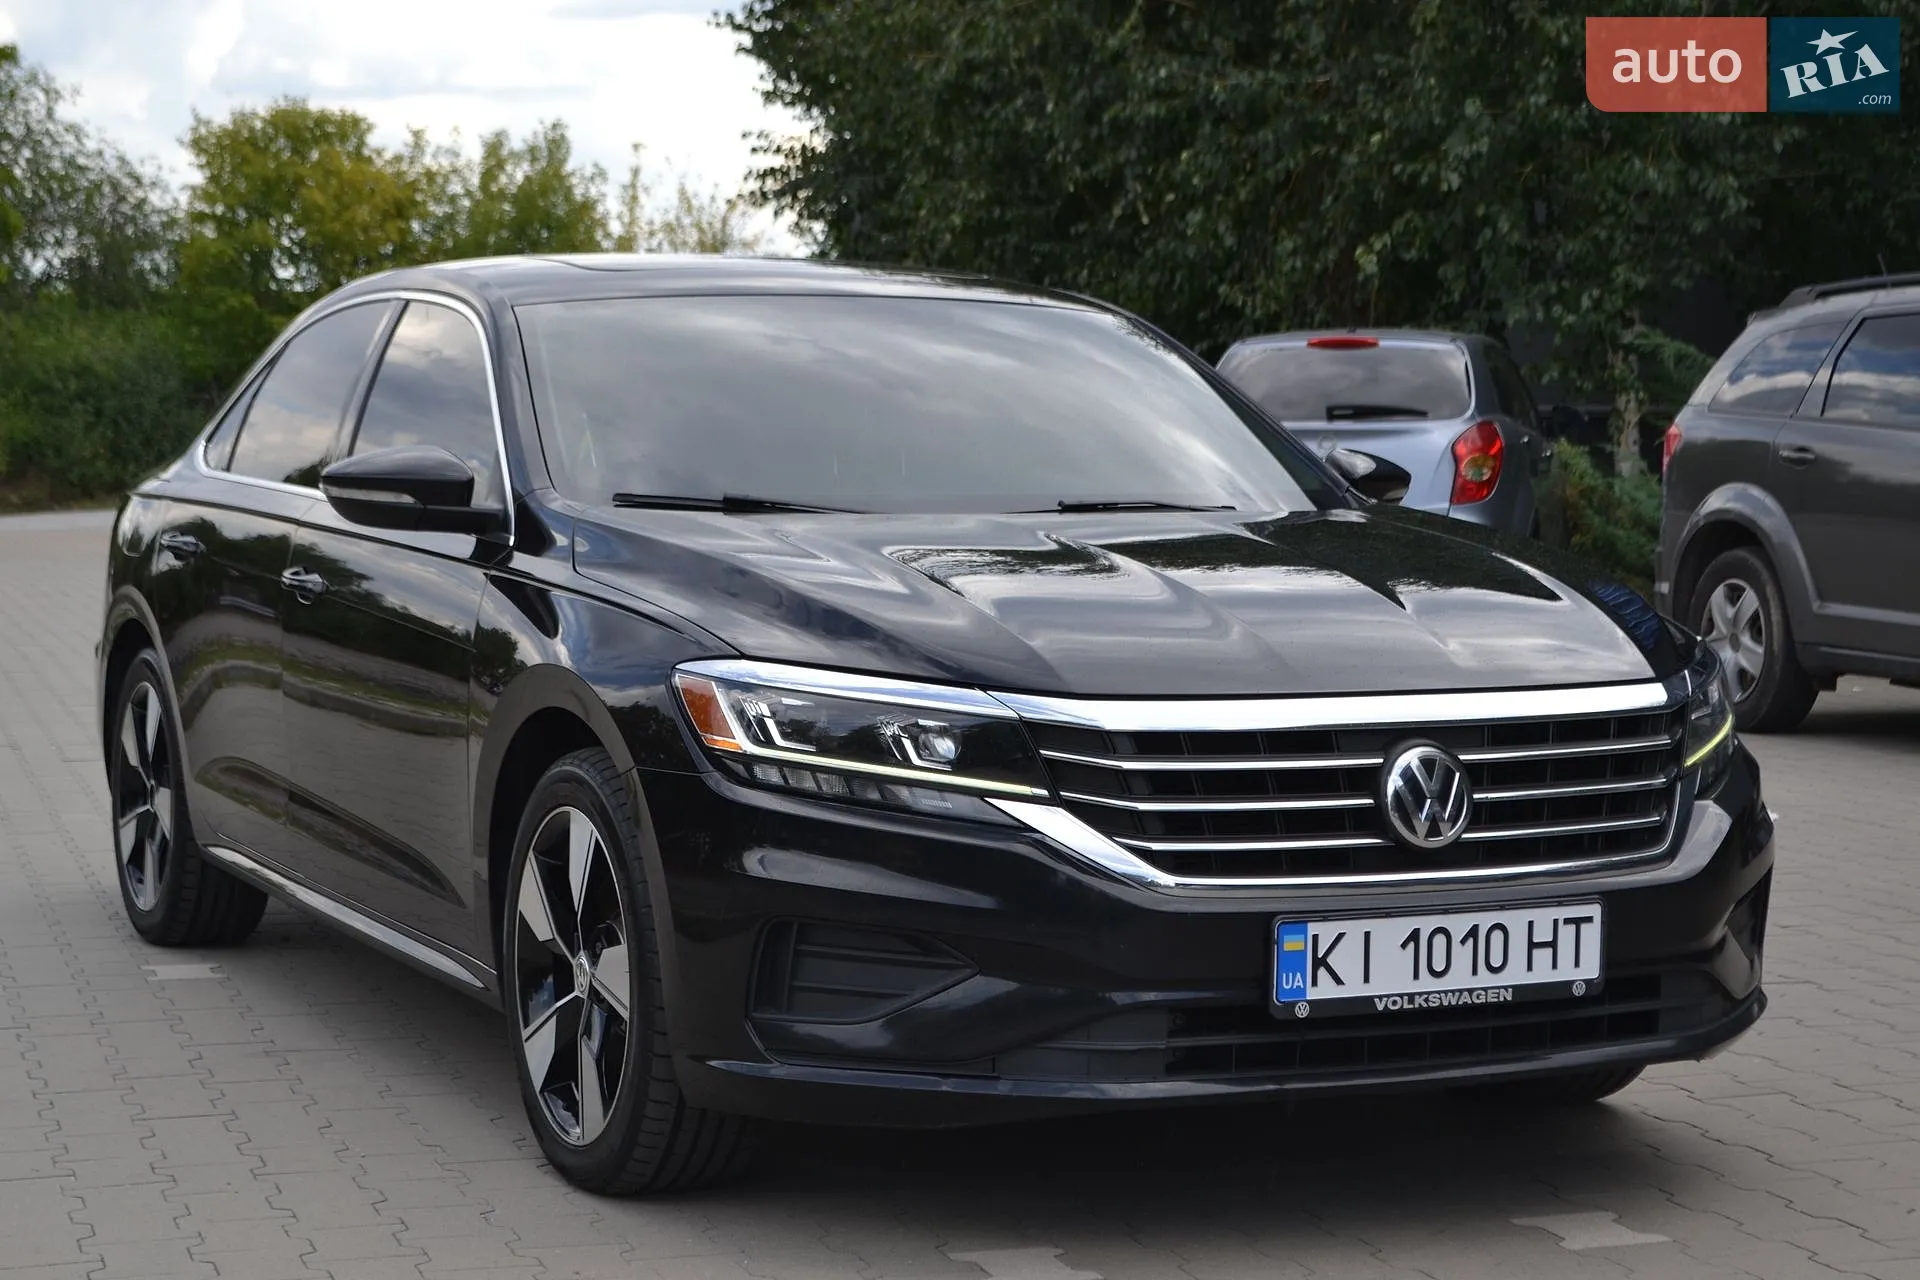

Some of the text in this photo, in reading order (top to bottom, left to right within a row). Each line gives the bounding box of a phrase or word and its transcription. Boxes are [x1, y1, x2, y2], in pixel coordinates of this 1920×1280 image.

[1311, 915, 1594, 988] KI 1010 HT
[1283, 972, 1304, 989] UA
[1374, 988, 1513, 1011] VOLKSWAGEN
